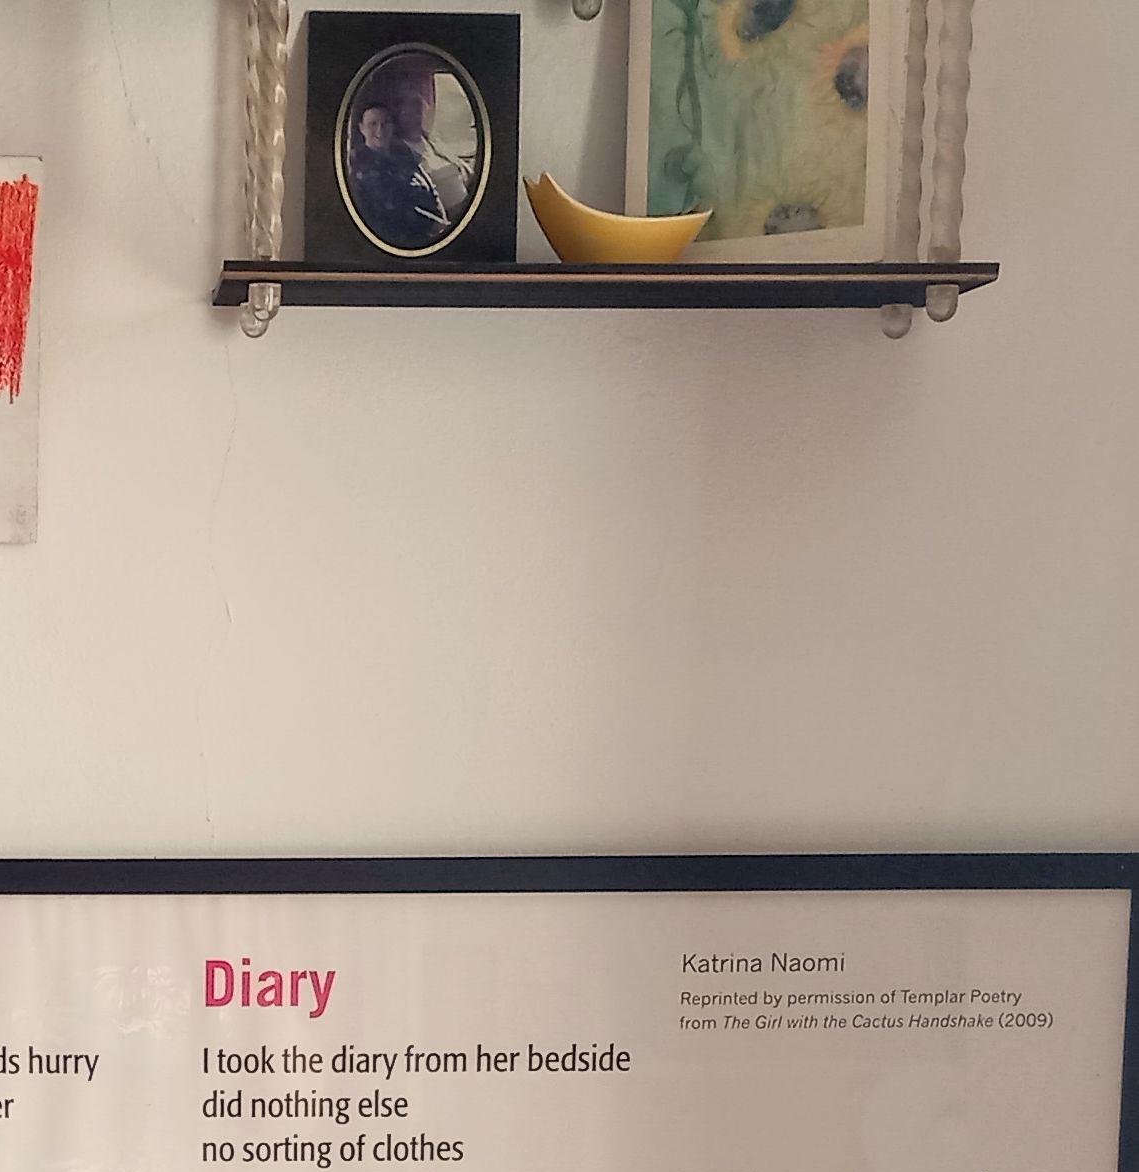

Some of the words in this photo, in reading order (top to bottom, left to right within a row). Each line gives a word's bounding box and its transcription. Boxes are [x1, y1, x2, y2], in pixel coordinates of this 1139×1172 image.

[683, 954, 761, 973] Katrina
[771, 952, 846, 973] Naomi
[206, 958, 335, 1018] Diary
[681, 992, 757, 1008] Reprinted
[764, 992, 782, 1008] by
[787, 990, 875, 1007] permission
[881, 990, 896, 1003] of
[901, 989, 965, 1006] Templar
[971, 989, 1021, 1006] Poetry
[680, 1016, 716, 1029] from
[724, 1016, 750, 1029] The
[755, 1015, 782, 1029] Girl
[787, 1016, 817, 1028] with
[824, 1015, 847, 1028] the
[853, 1014, 903, 1028] Cactus
[909, 1014, 993, 1028] Handshake
[999, 1012, 1053, 1028] (2009)
[29, 1046, 99, 1081] hurry
[204, 1048, 208, 1073] I
[217, 1046, 275, 1073] took
[282, 1046, 323, 1073] the
[332, 1045, 398, 1080] diary
[405, 1045, 466, 1072] from
[477, 1044, 520, 1072] her
[529, 1043, 630, 1071] bedside
[203, 1090, 241, 1117] did
[252, 1090, 351, 1124] nothing
[359, 1089, 408, 1117] else
[203, 1143, 234, 1161] no
[243, 1134, 332, 1168] sorting
[340, 1134, 366, 1161] of
[373, 1133, 463, 1161] clothes
